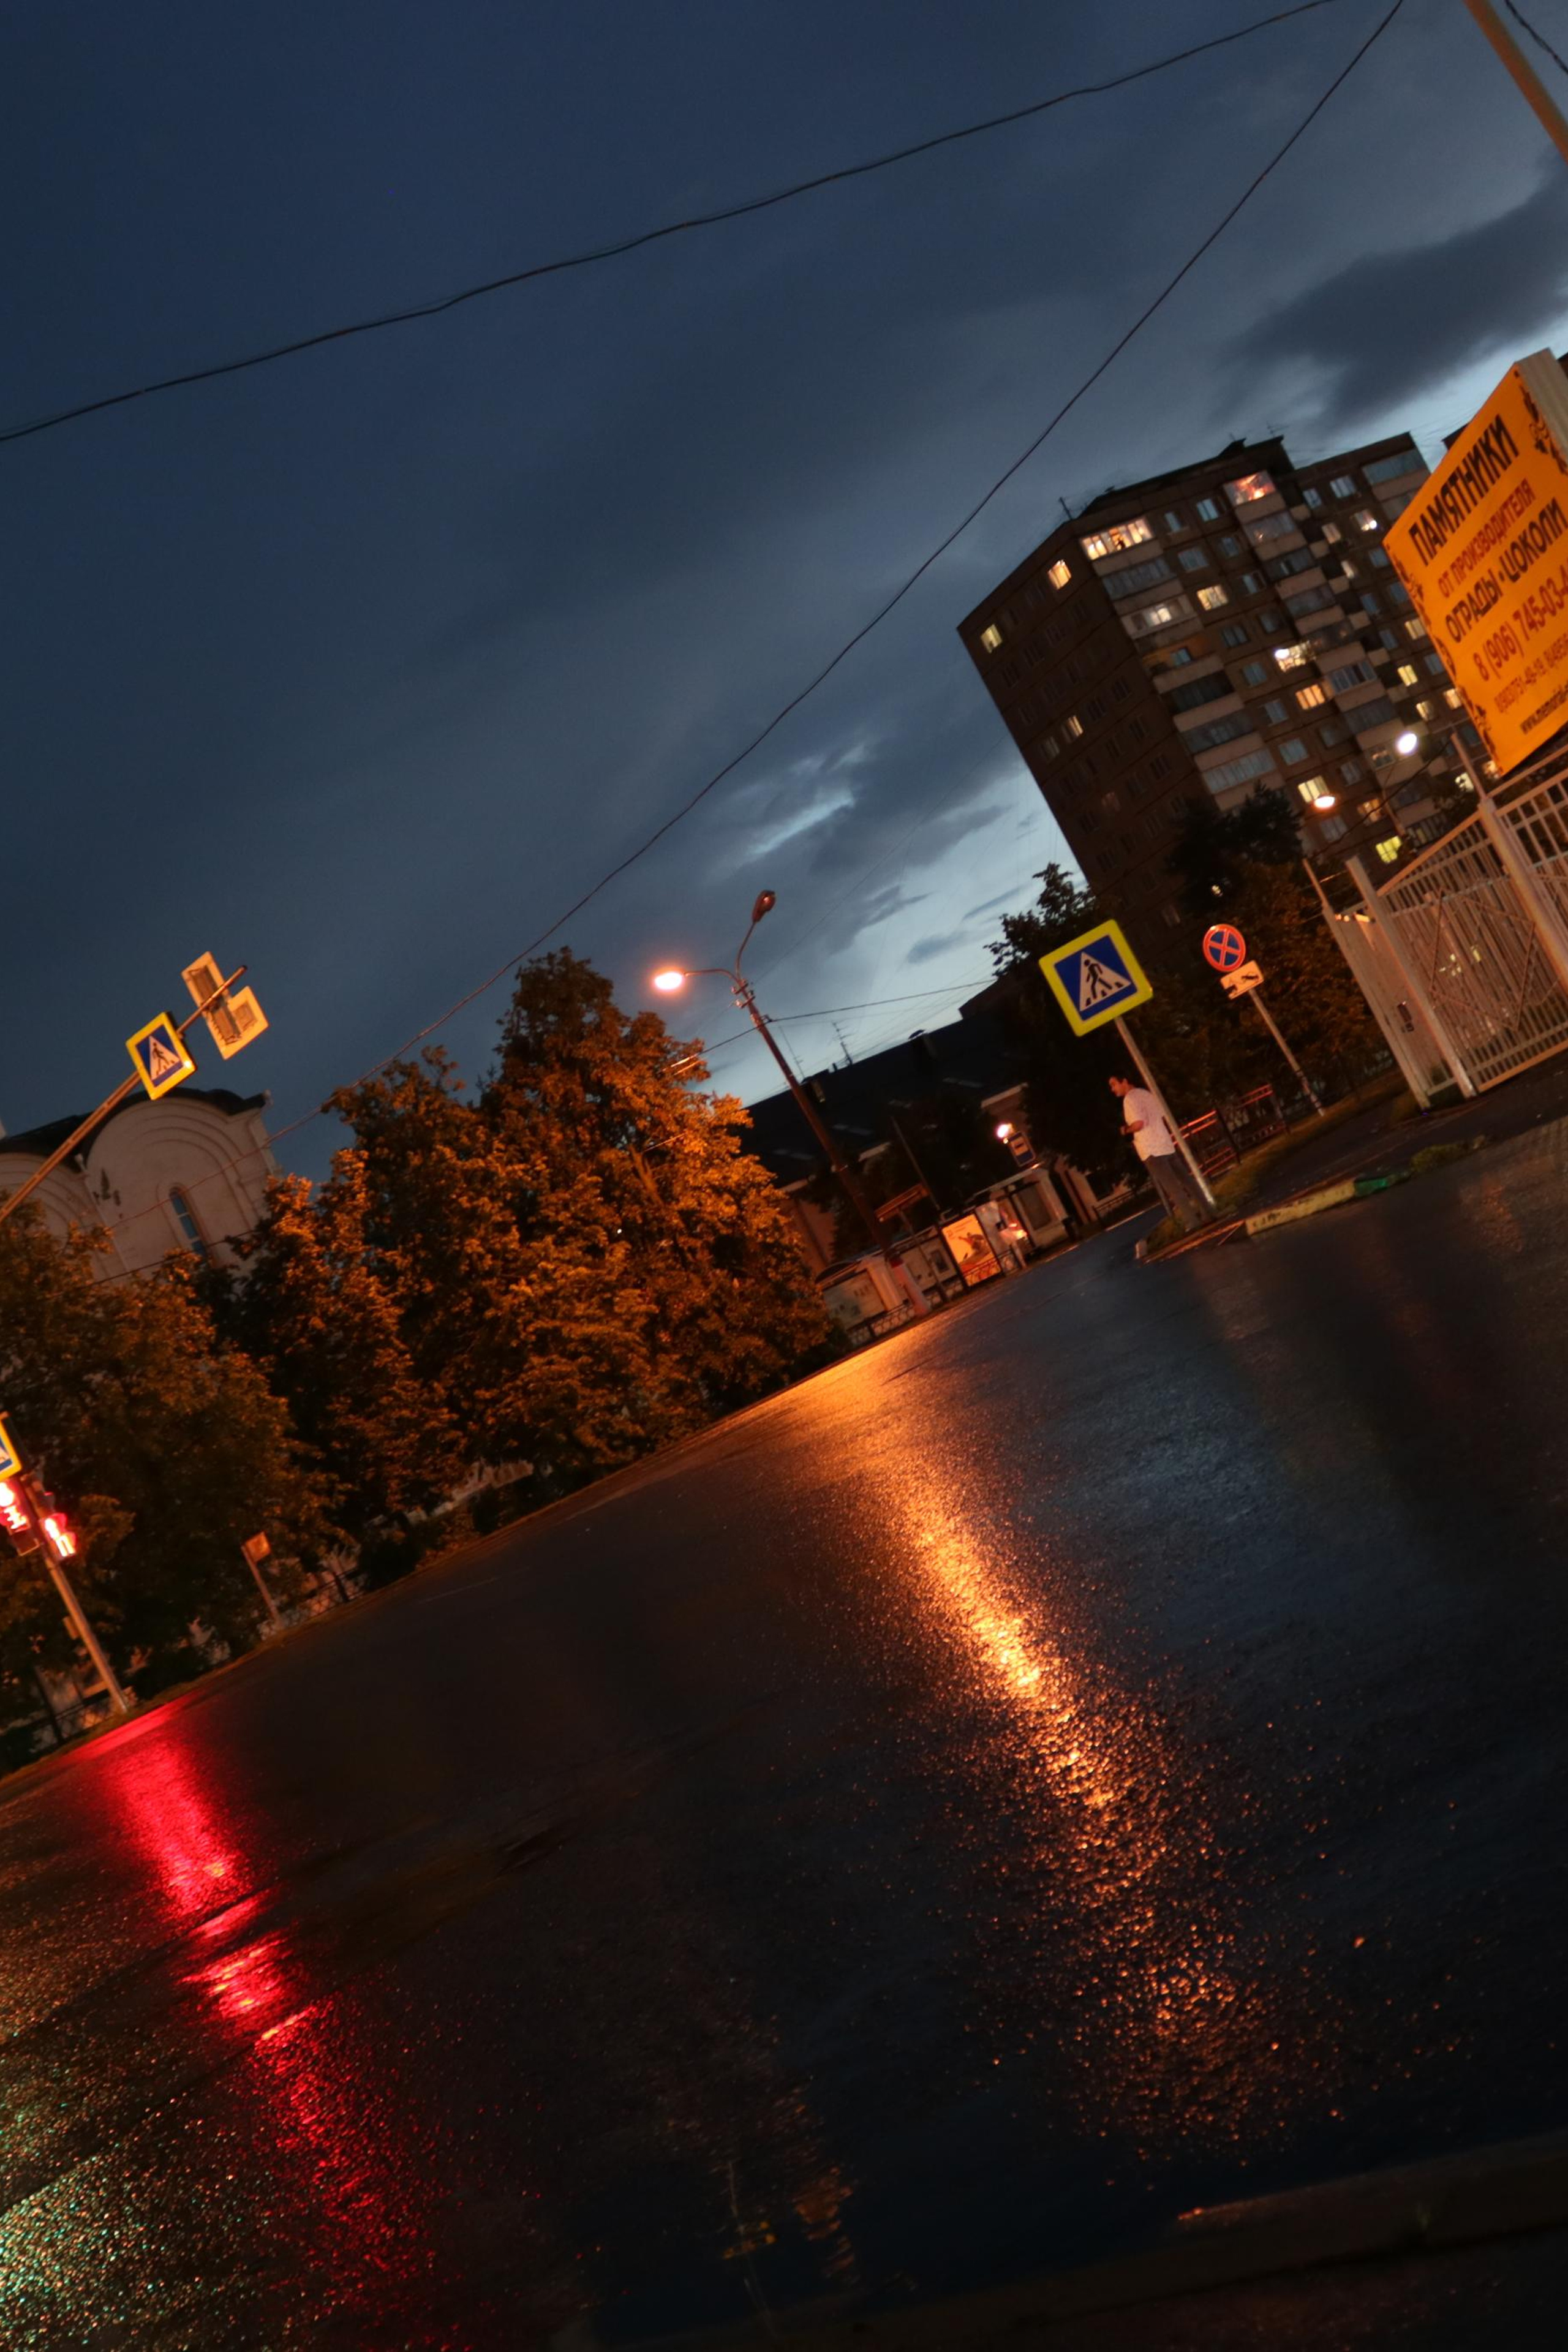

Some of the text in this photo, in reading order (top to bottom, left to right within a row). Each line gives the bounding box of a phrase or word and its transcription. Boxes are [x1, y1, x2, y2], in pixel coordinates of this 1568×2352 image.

[1409, 413, 1519, 566] ПАМЯТНИКИ
[1438, 477, 1536, 598] ОТ ПРОИЗВОДИТЕЛЯ
[1446, 497, 1568, 643] ОГРАДЫ ЦОКОЛИ
[1473, 556, 1568, 681] 8 (906) 745-03-4
